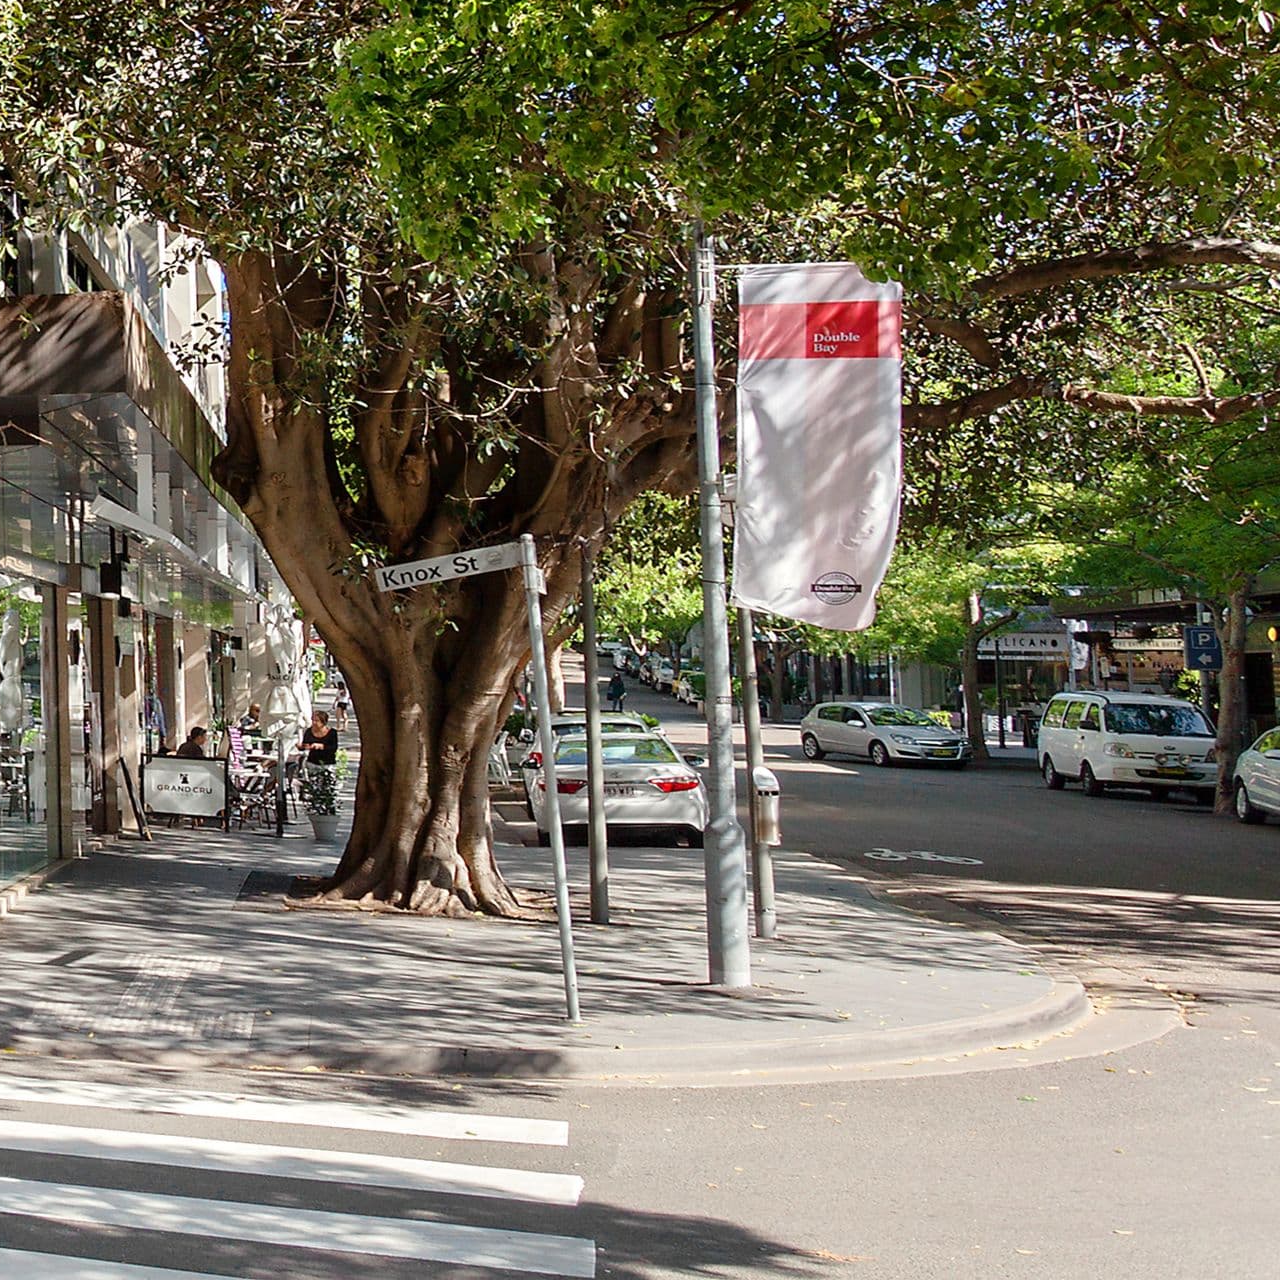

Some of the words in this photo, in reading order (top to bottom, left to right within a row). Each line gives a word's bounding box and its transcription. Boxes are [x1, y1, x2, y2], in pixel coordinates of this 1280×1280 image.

[813, 332, 860, 342] Double
[813, 343, 838, 354] Bay
[382, 565, 442, 587] Knox
[453, 556, 479, 574] St
[984, 637, 1058, 647] PLICANO
[1198, 633, 1211, 646] P
[156, 784, 192, 793] GRAND
[192, 787, 213, 795] CRU
